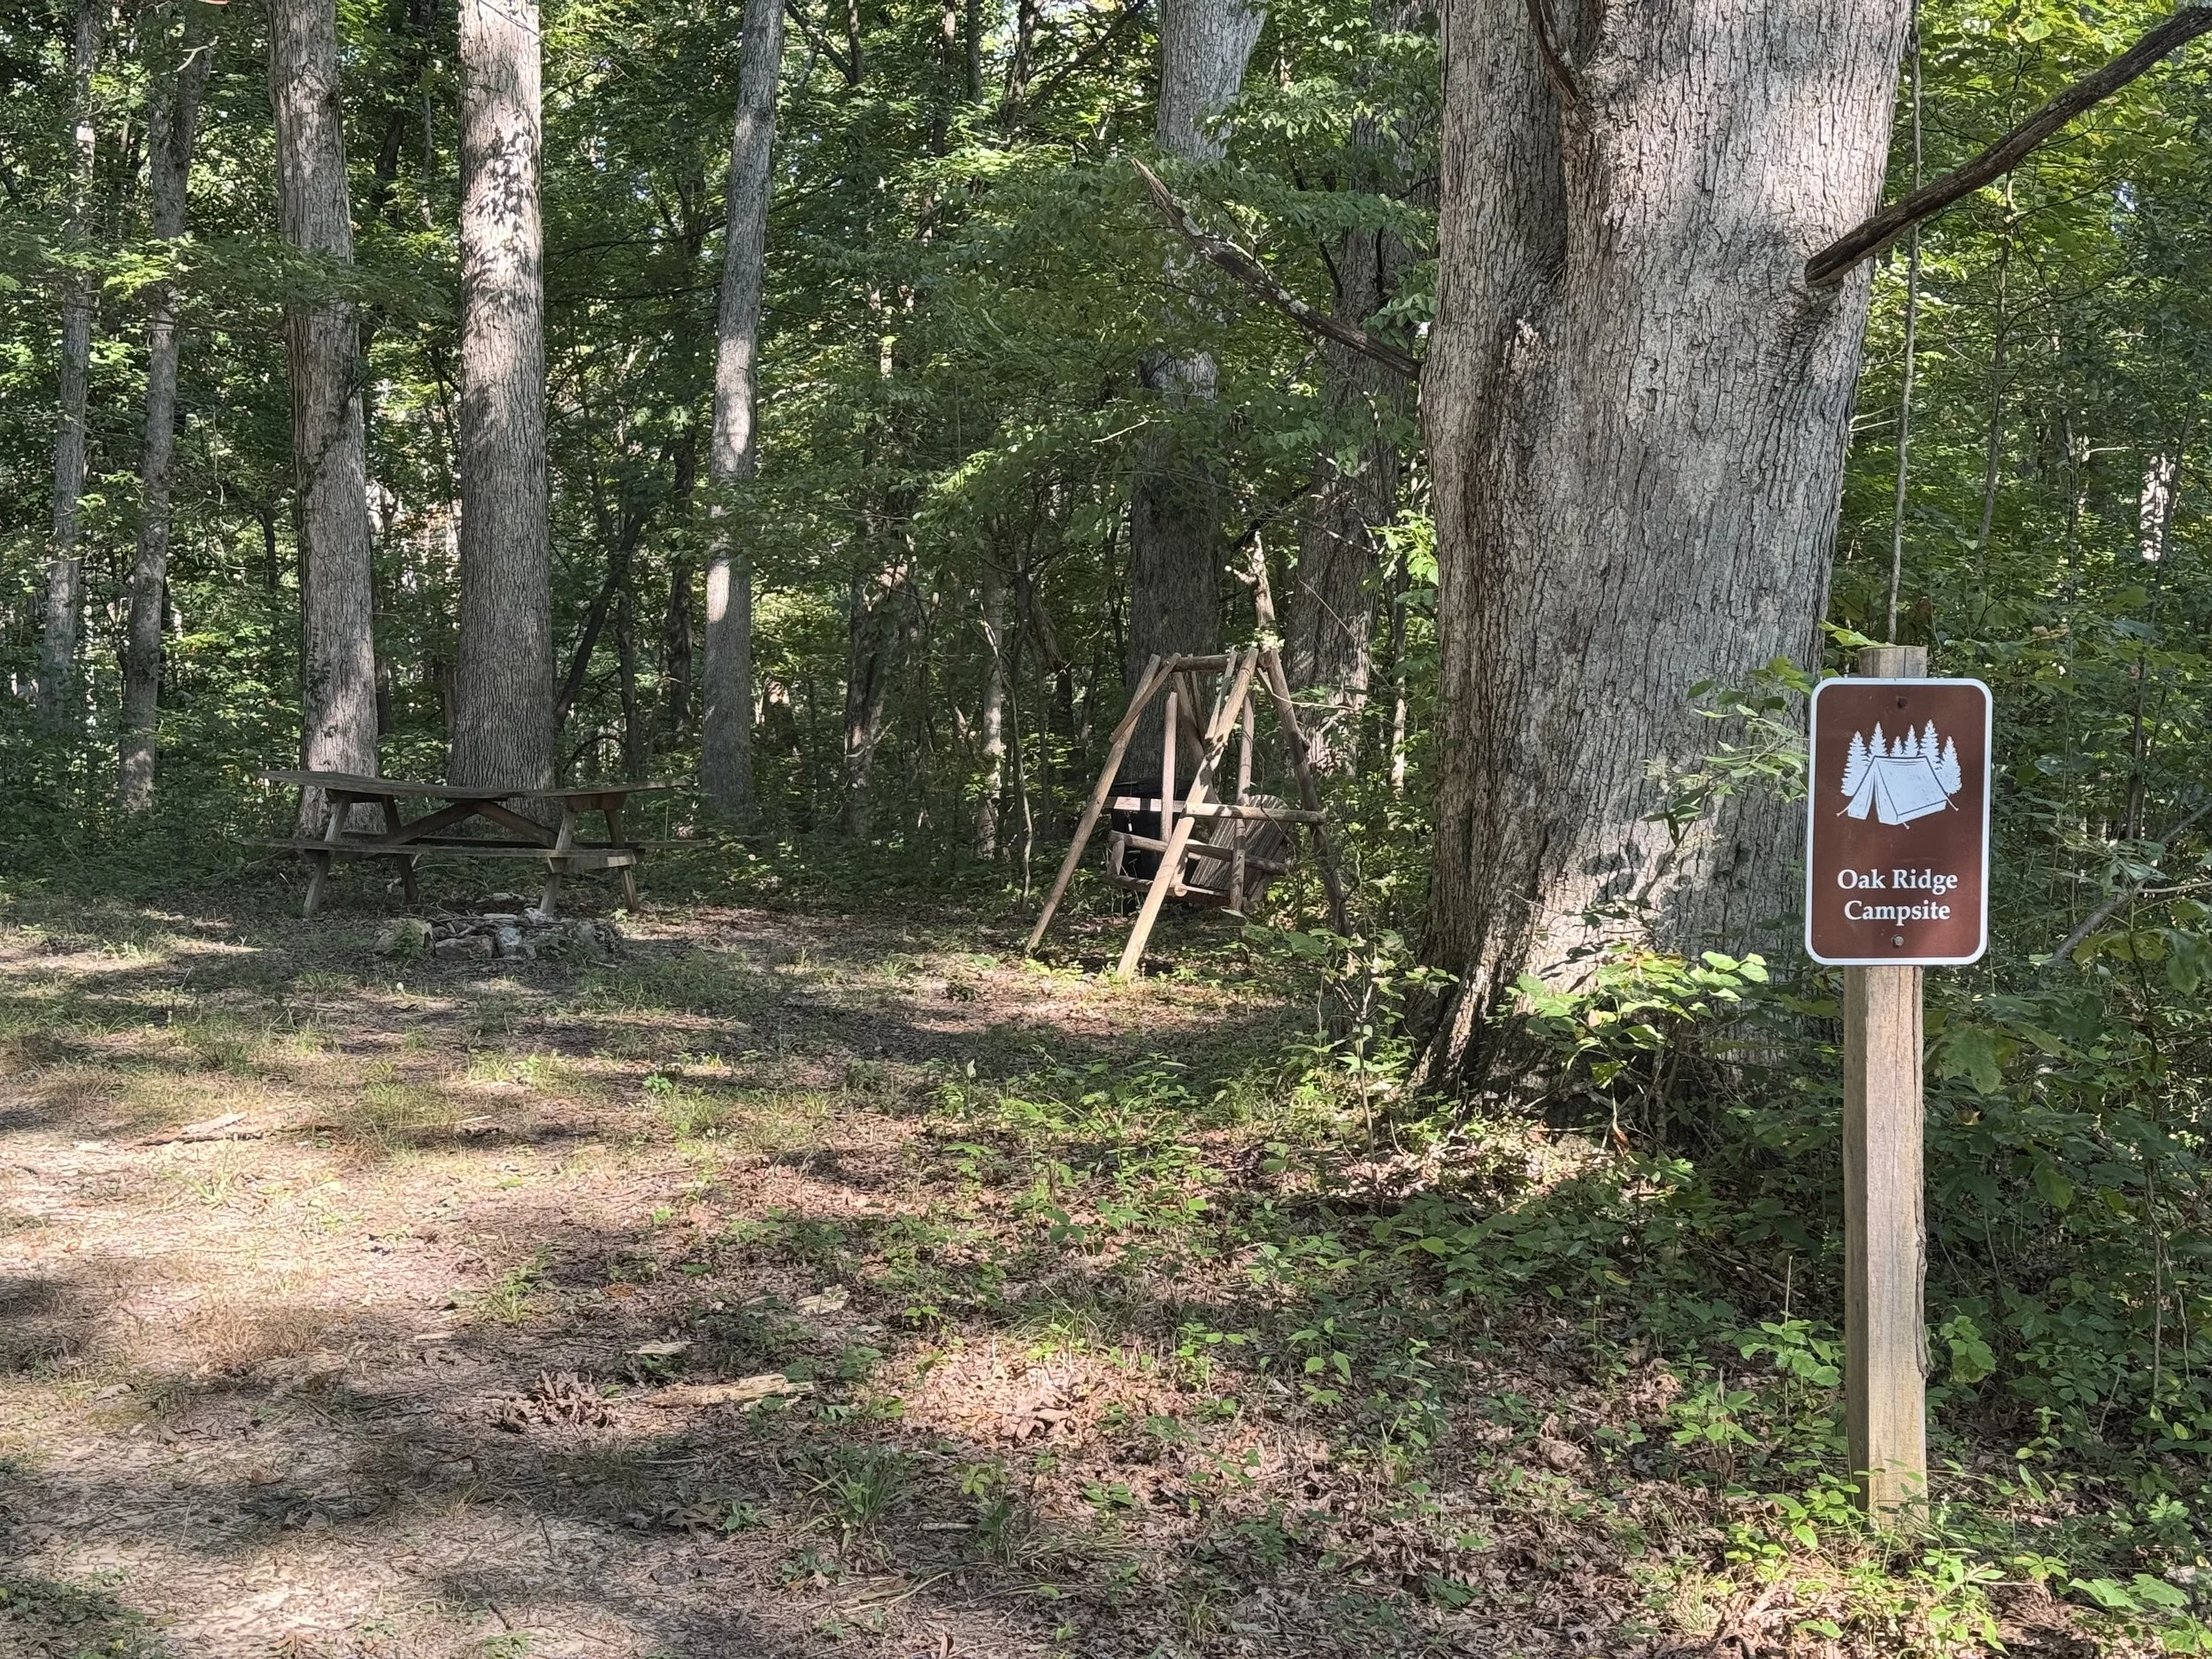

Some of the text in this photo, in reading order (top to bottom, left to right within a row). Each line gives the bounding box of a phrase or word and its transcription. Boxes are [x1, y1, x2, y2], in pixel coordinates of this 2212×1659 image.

[1837, 868, 1958, 895] Oak Ridge
[1844, 900, 1951, 926] Campsite
